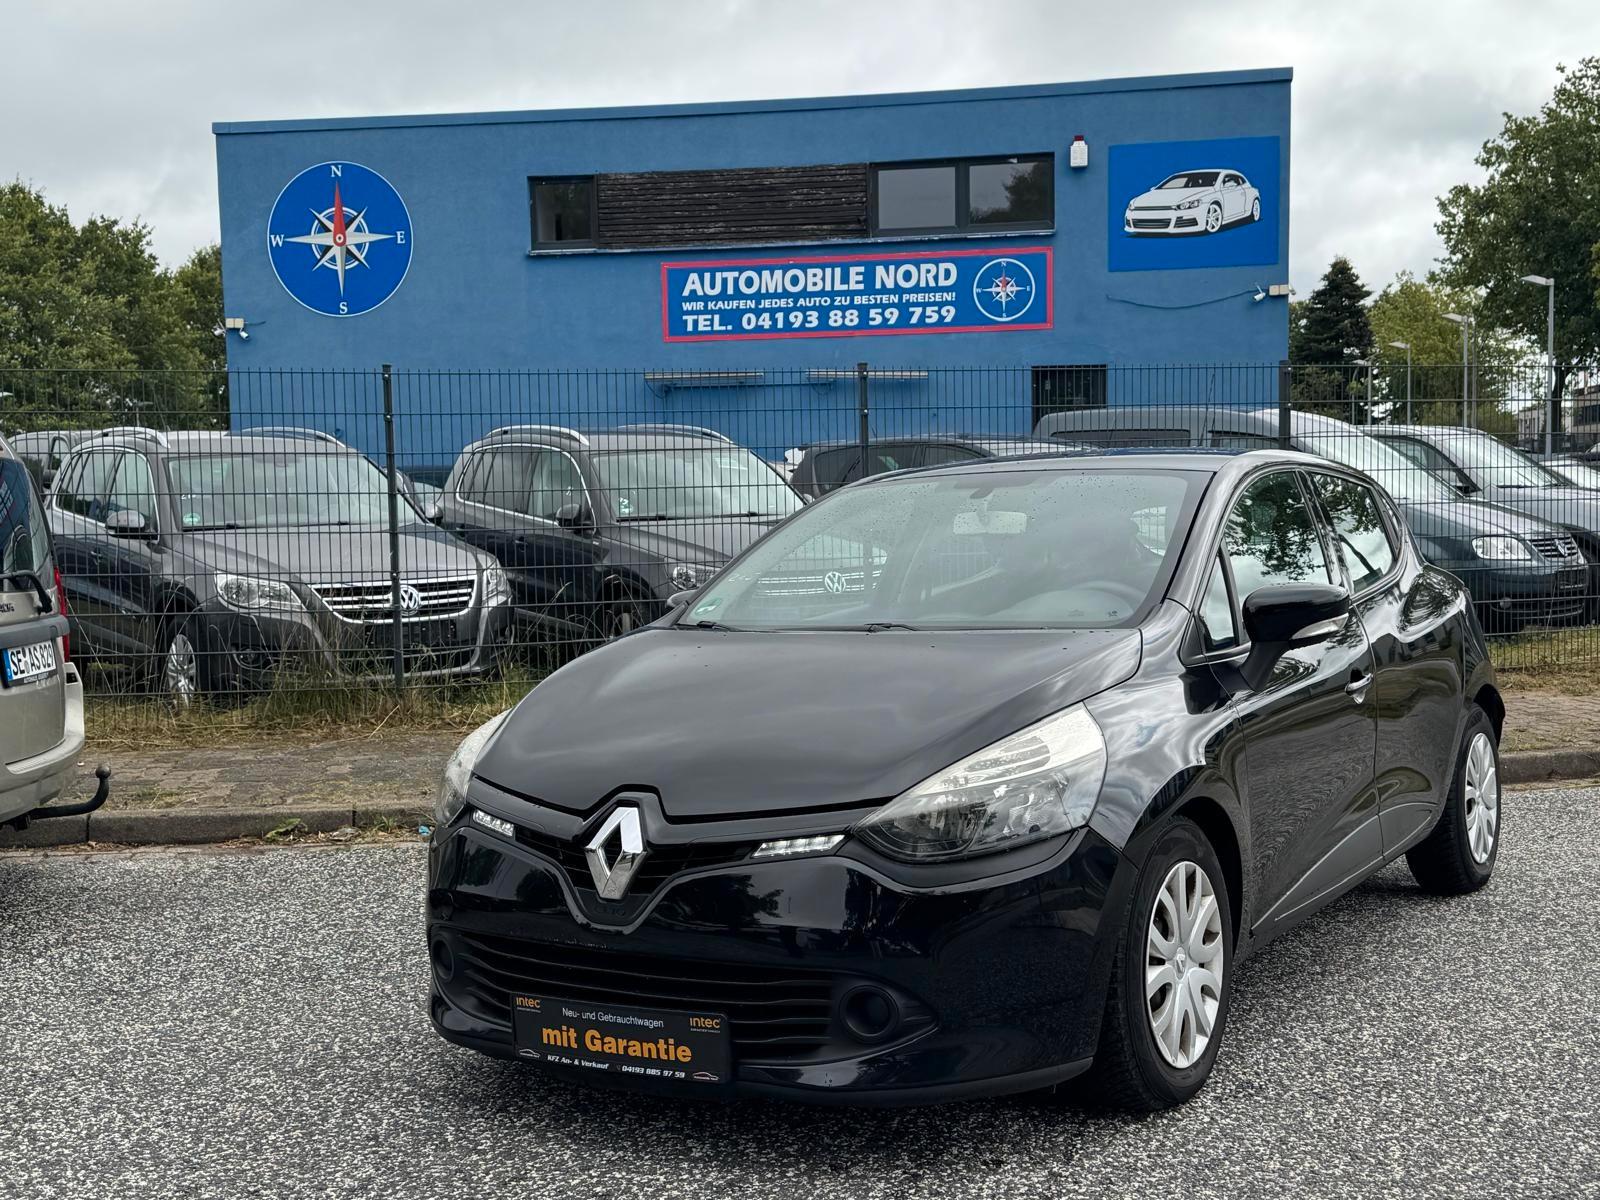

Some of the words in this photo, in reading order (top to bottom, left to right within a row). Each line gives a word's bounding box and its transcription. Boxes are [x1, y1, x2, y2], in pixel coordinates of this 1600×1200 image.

[330, 165, 342, 177] N
[270, 234, 285, 247] W
[395, 231, 406, 244] E
[682, 266, 865, 297] AUTOMOBILE
[875, 262, 958, 290] NORD
[339, 301, 348, 314] S
[682, 301, 704, 311] WIR
[708, 299, 755, 310] KAUFEN
[758, 298, 794, 309] JEDES
[797, 296, 830, 307] AUTO
[834, 296, 850, 306] ZU
[853, 294, 899, 305] BESTEN
[902, 292, 956, 303] PREISEN!
[682, 314, 733, 331] TEL.
[741, 310, 819, 329] 04193
[828, 309, 859, 327] 88
[868, 307, 899, 326] 59
[908, 305, 956, 324] 759
[10, 649, 26, 676] SE
[28, 645, 41, 672] AS
[515, 996, 541, 1009] intec
[562, 1007, 580, 1018] Neu-
[581, 1011, 596, 1020] und
[597, 1011, 664, 1029] Gebrauchtwagen
[689, 1017, 720, 1029] intec
[542, 1025, 578, 1049] mit
[584, 1029, 692, 1063] Garantie
[547, 1054, 560, 1062] KFZ
[581, 1060, 609, 1070] Verkauf
[621, 1065, 645, 1074] 04193
[645, 1068, 661, 1076] 885
[674, 1071, 686, 1079] 59
